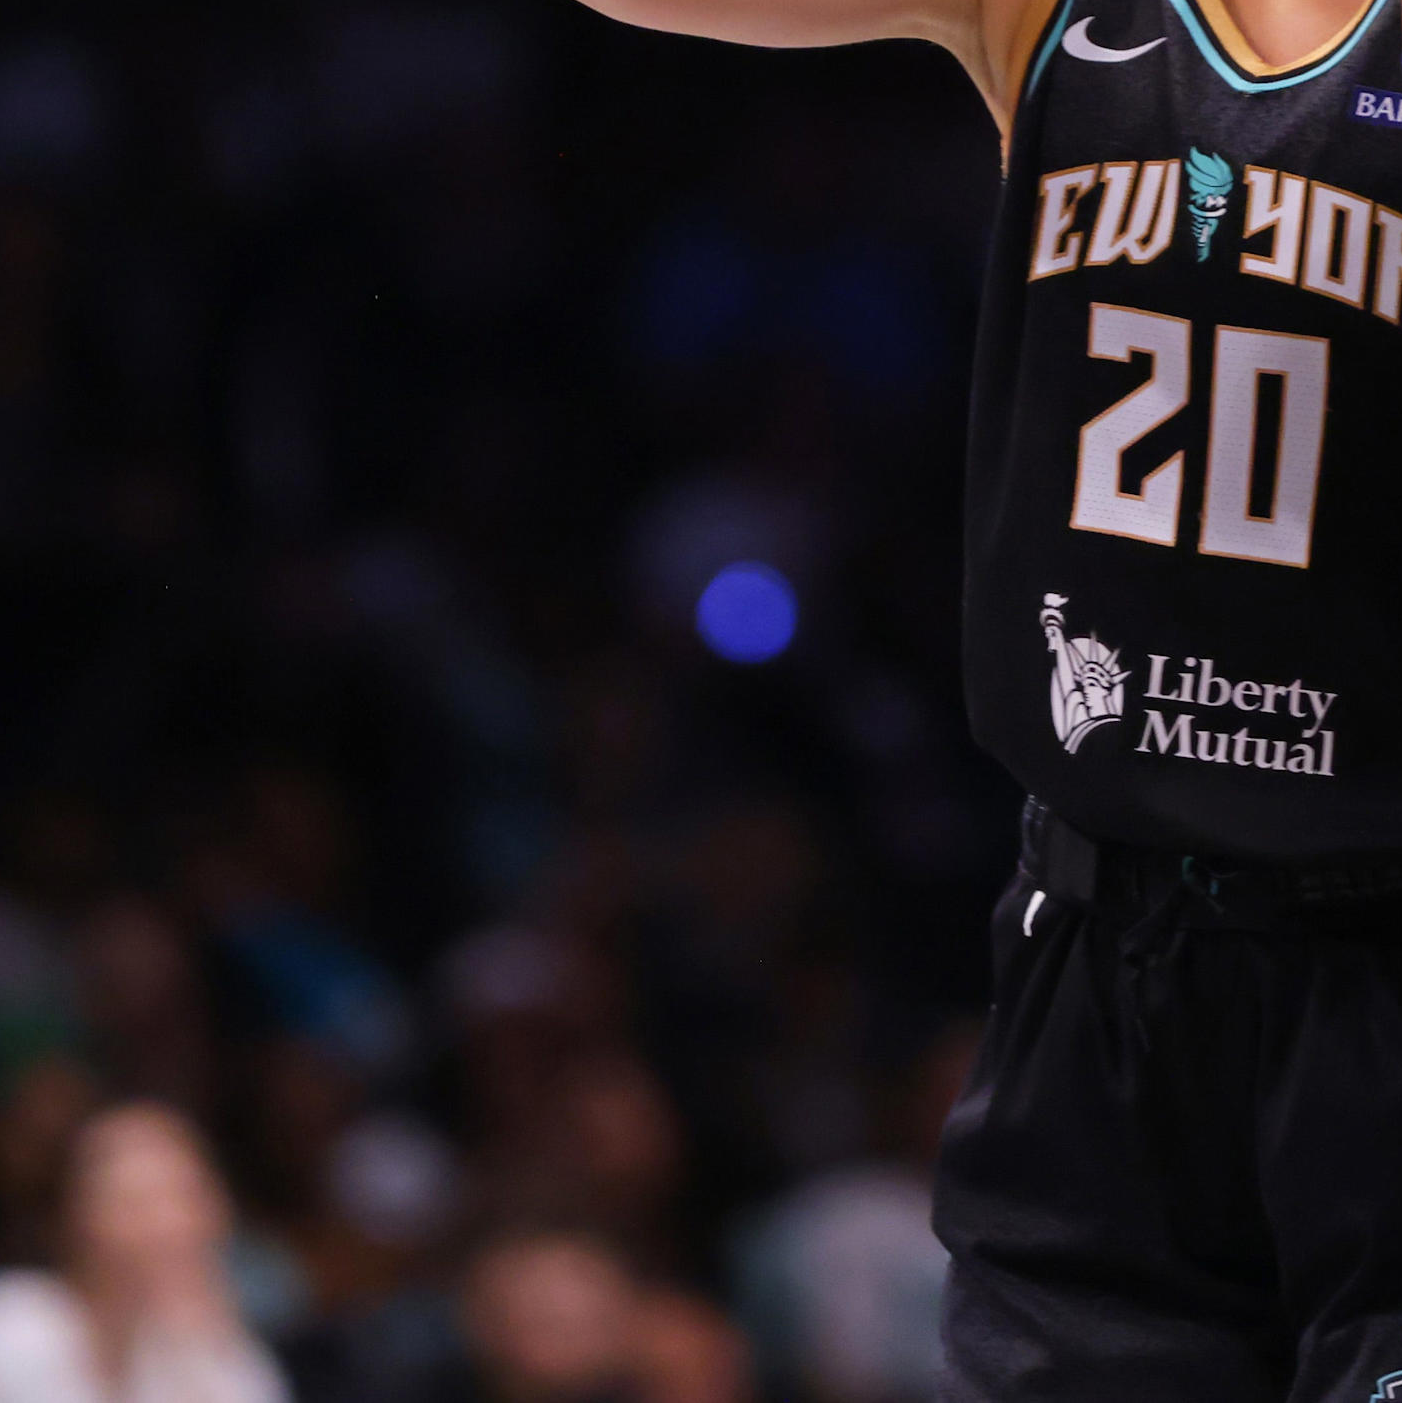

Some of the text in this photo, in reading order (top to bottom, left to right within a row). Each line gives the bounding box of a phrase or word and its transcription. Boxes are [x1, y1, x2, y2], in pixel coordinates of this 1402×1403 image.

[1027, 158, 1182, 282] EW
[1069, 302, 1331, 569] 20
[1134, 709, 1334, 776] Mutual
[1143, 654, 1338, 738] Liberty
